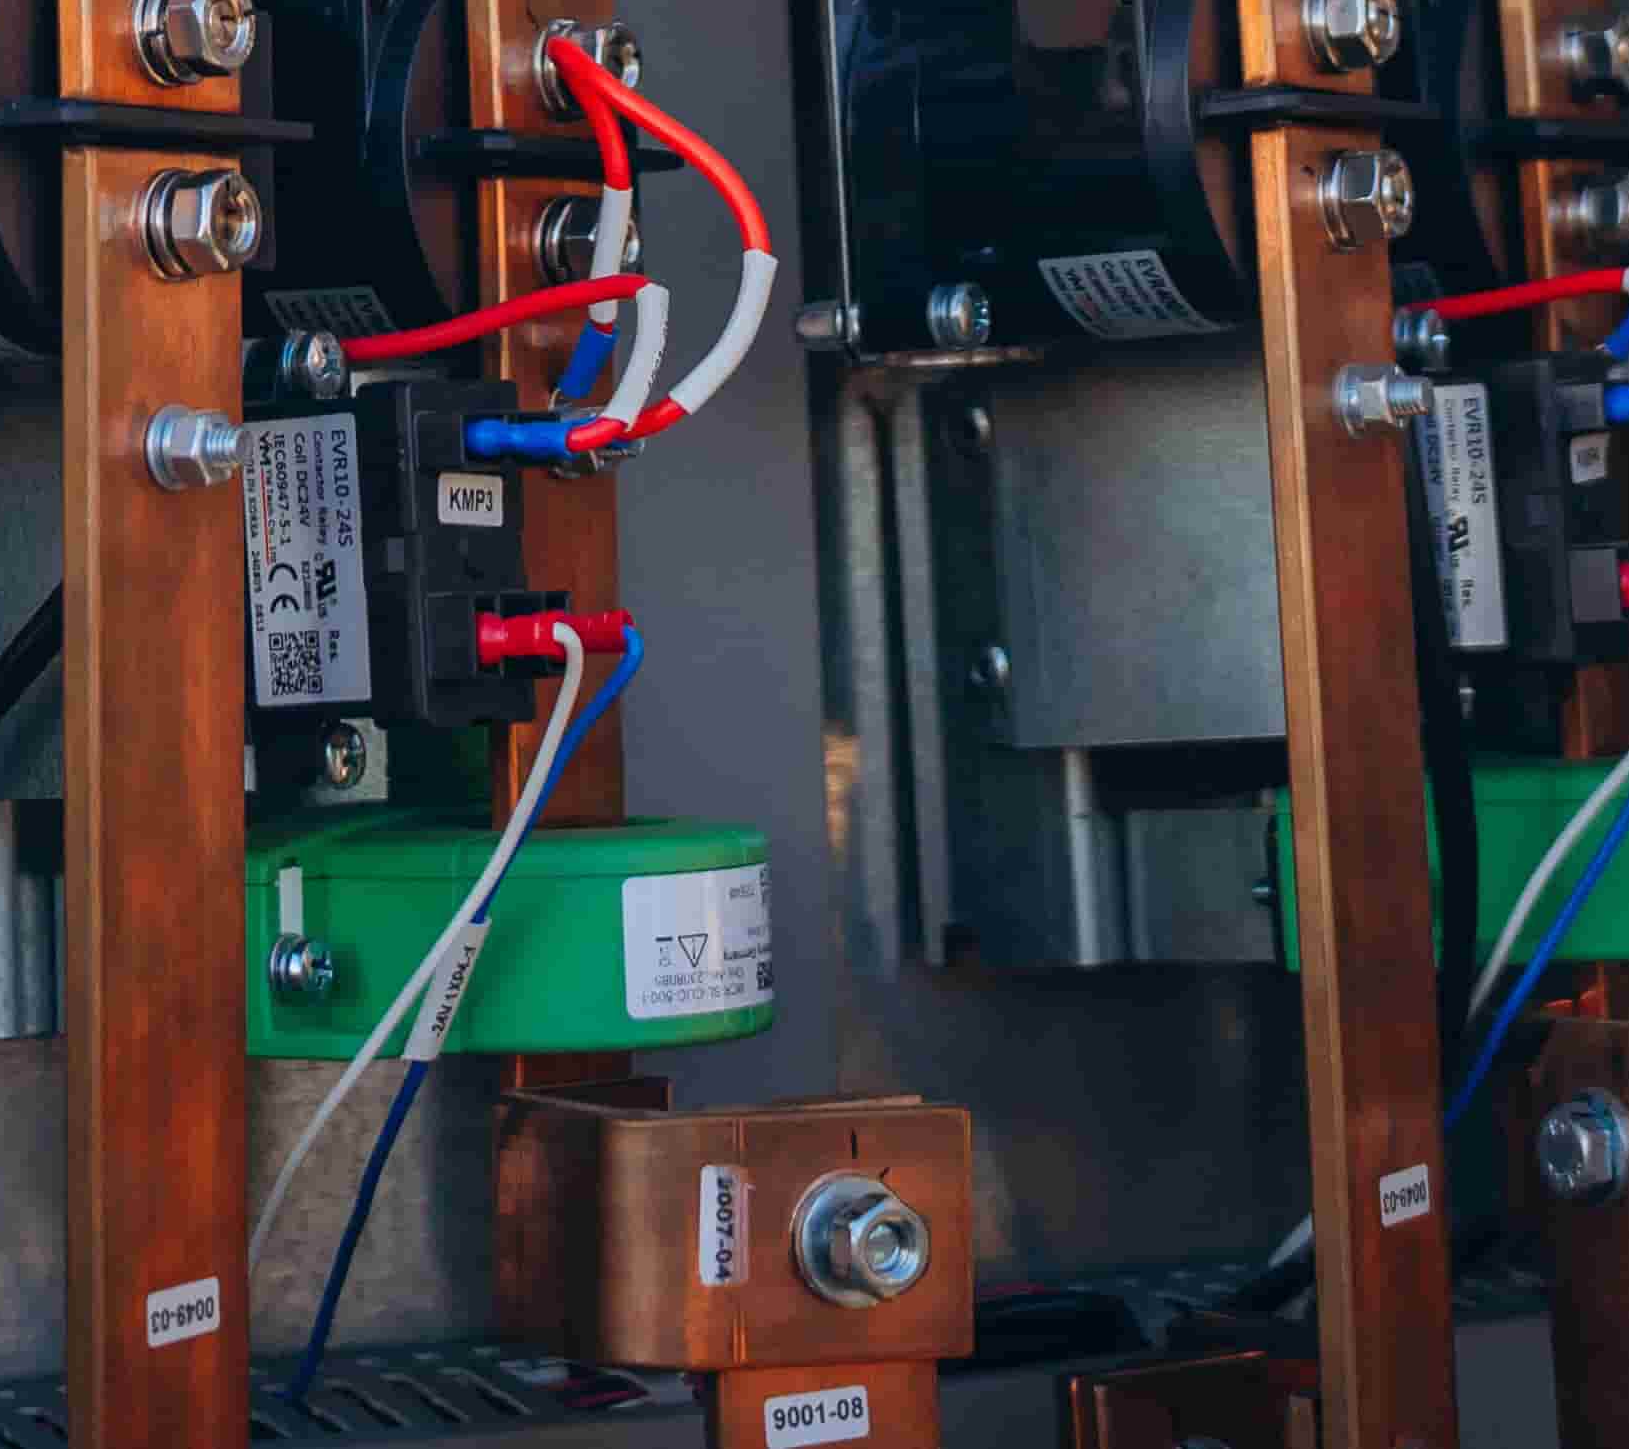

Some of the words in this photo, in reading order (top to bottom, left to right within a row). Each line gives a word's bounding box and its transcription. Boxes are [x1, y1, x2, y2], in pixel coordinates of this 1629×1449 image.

[293, 431, 308, 464] Coil
[313, 429, 327, 501] Contactor
[273, 432, 292, 546] IEC60947-5-1
[295, 469, 311, 528] DC24V
[329, 428, 355, 549] EVR10-24S
[448, 485, 495, 513] KMP3
[314, 505, 329, 547] Relay
[268, 562, 301, 615] CE
[150, 1296, 215, 1337] 0049-03
[772, 1395, 866, 1432] 9001-08
